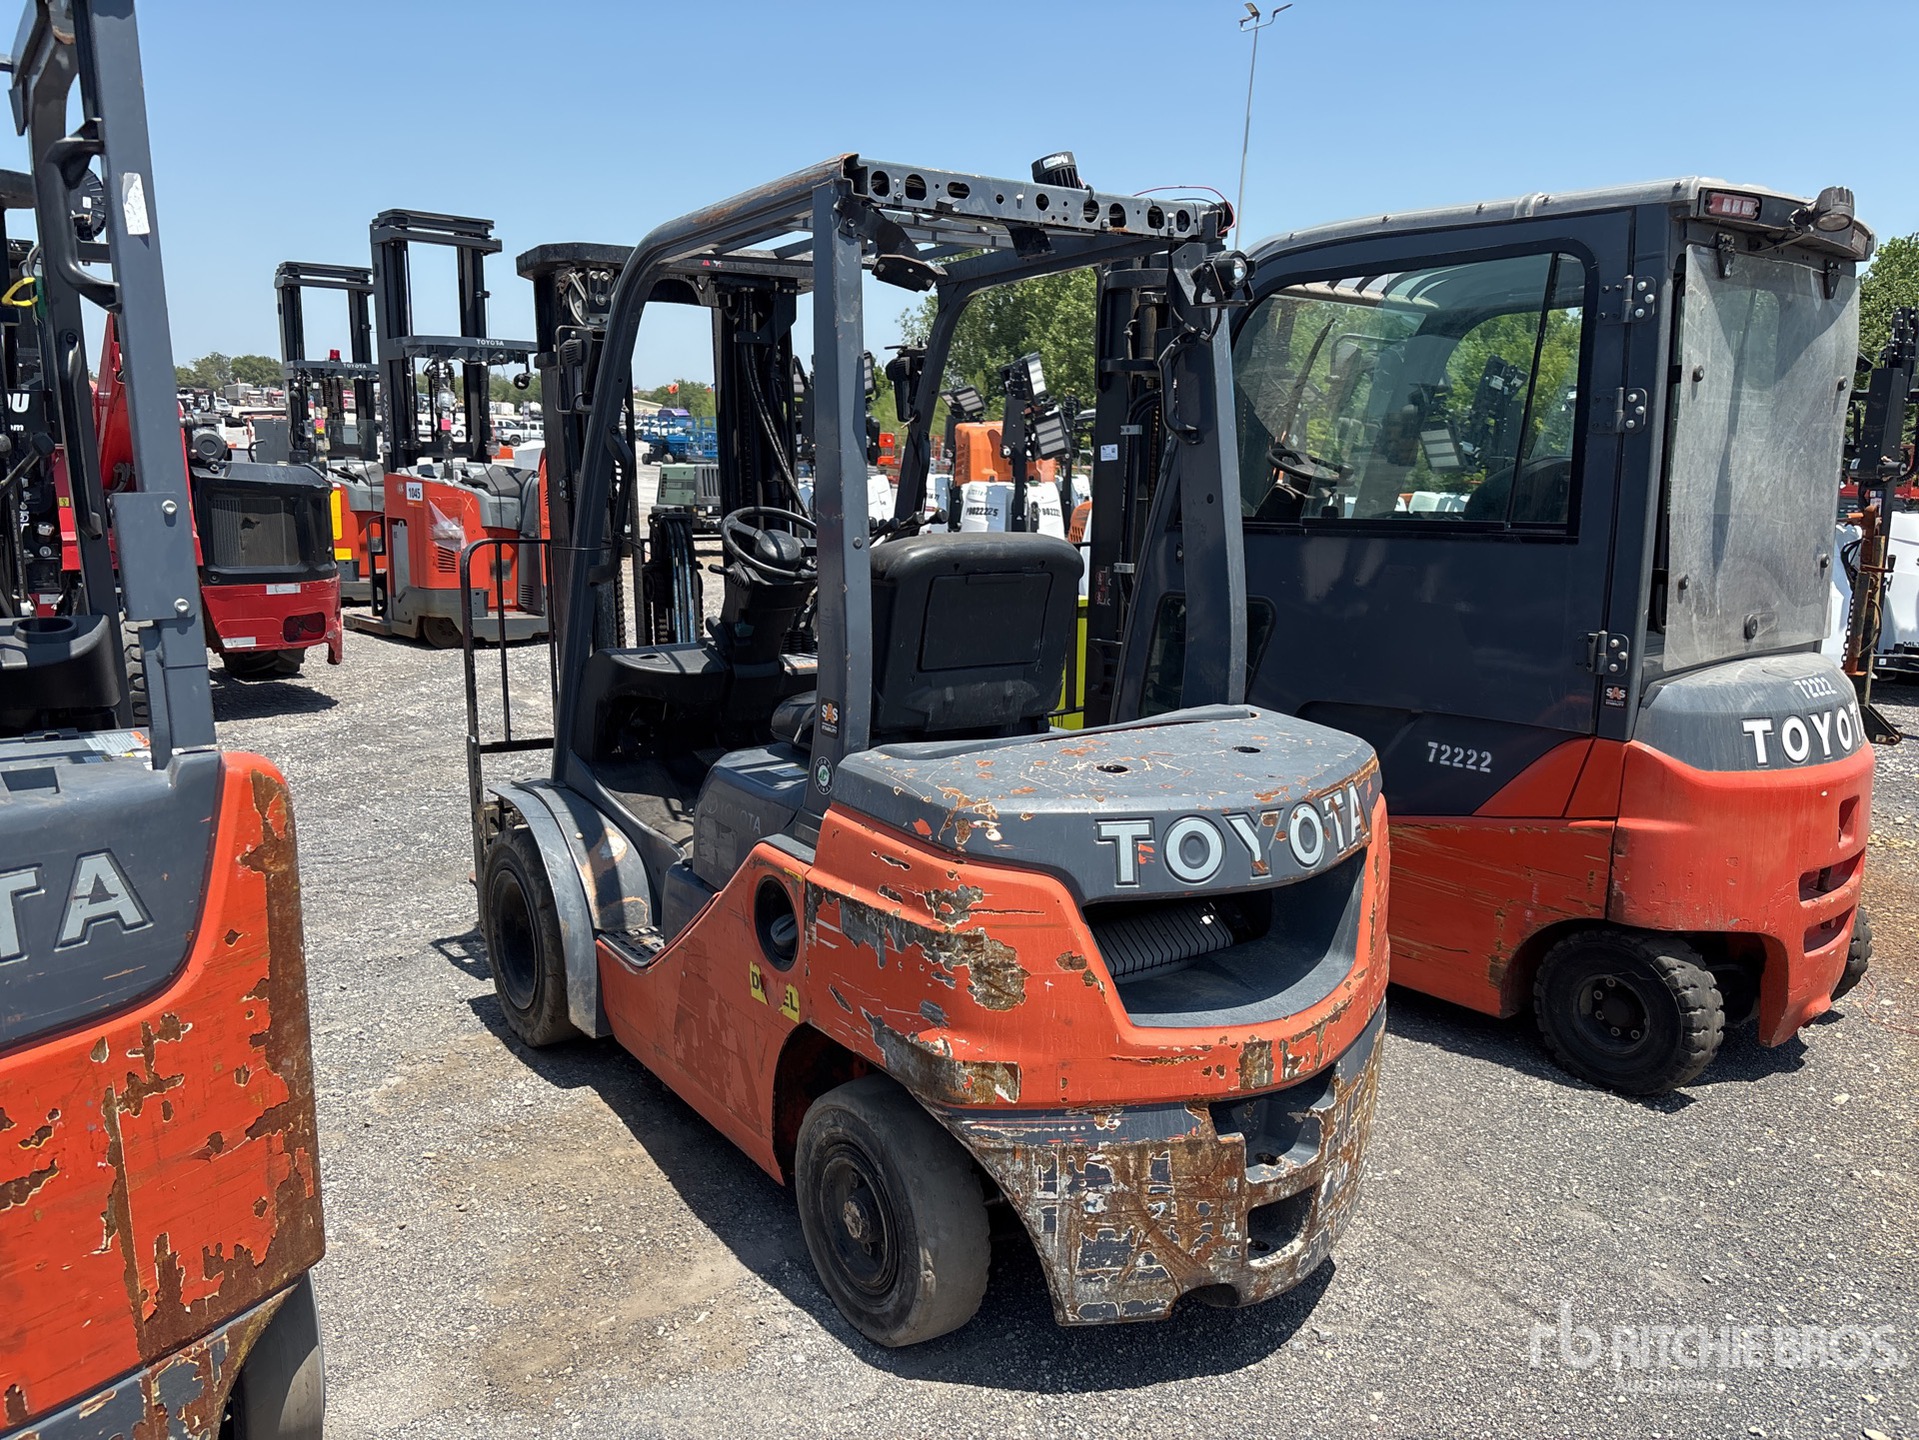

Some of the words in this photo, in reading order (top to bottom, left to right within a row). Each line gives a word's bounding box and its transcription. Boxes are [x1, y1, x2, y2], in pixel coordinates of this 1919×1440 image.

[476, 338, 505, 347] TOYOTA
[408, 487, 421, 499] 1045
[1605, 686, 1626, 700] SAS
[1792, 676, 1838, 699] 72222
[821, 703, 839, 724] SAS
[1427, 741, 1492, 773] 72222
[1095, 781, 1370, 887] TOYOTA
